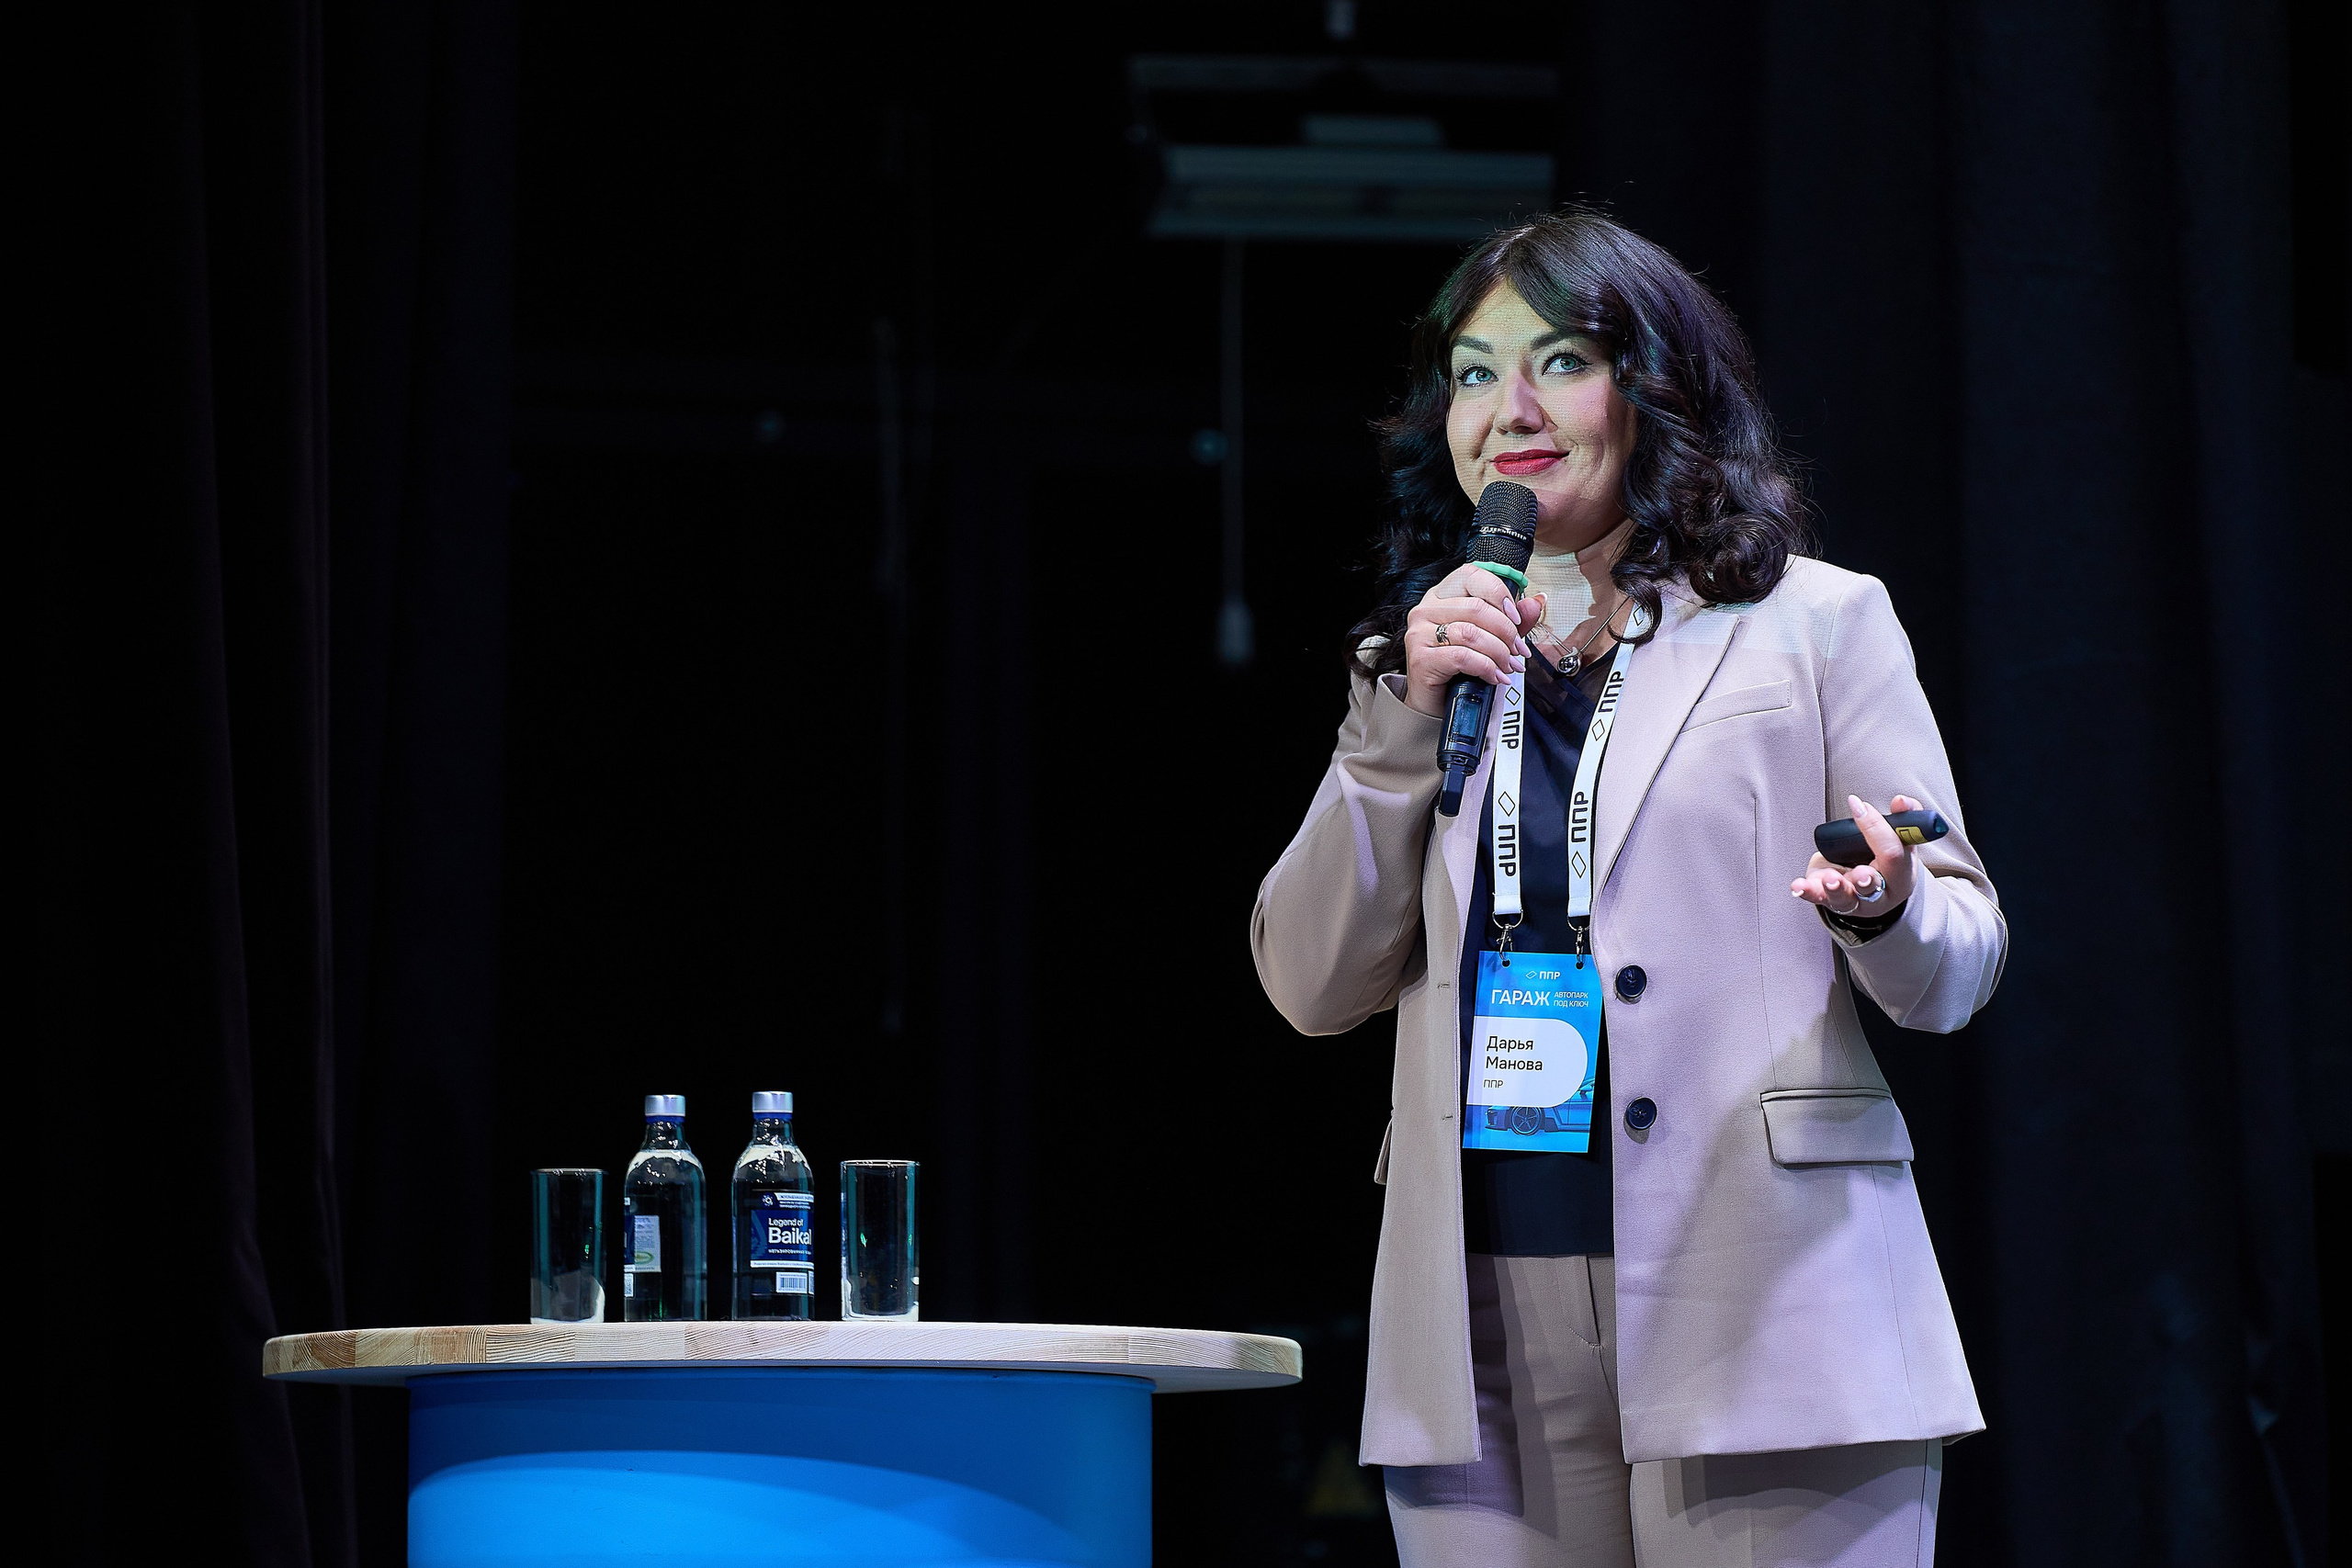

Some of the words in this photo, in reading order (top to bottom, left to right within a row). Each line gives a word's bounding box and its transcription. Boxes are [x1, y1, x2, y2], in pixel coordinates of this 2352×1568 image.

[1598, 671, 1624, 713] ППР
[1501, 710, 1521, 750] ППР
[1571, 791, 1589, 843] ППР
[1498, 824, 1517, 877] ППР
[1539, 970, 1561, 980] ППР
[1491, 988, 1551, 1007] ГАРАЖ
[1553, 999, 1568, 1008] ПОД
[1569, 999, 1589, 1008] КЛЮЧ
[1554, 991, 1589, 999] АВТОПАРК
[1486, 1035, 1534, 1053] Дарья
[1485, 1055, 1544, 1071] Манова
[1483, 1079, 1504, 1089] ППР
[768, 1217, 797, 1228] Legend
[797, 1218, 804, 1227] of
[768, 1227, 812, 1246] Baikal
